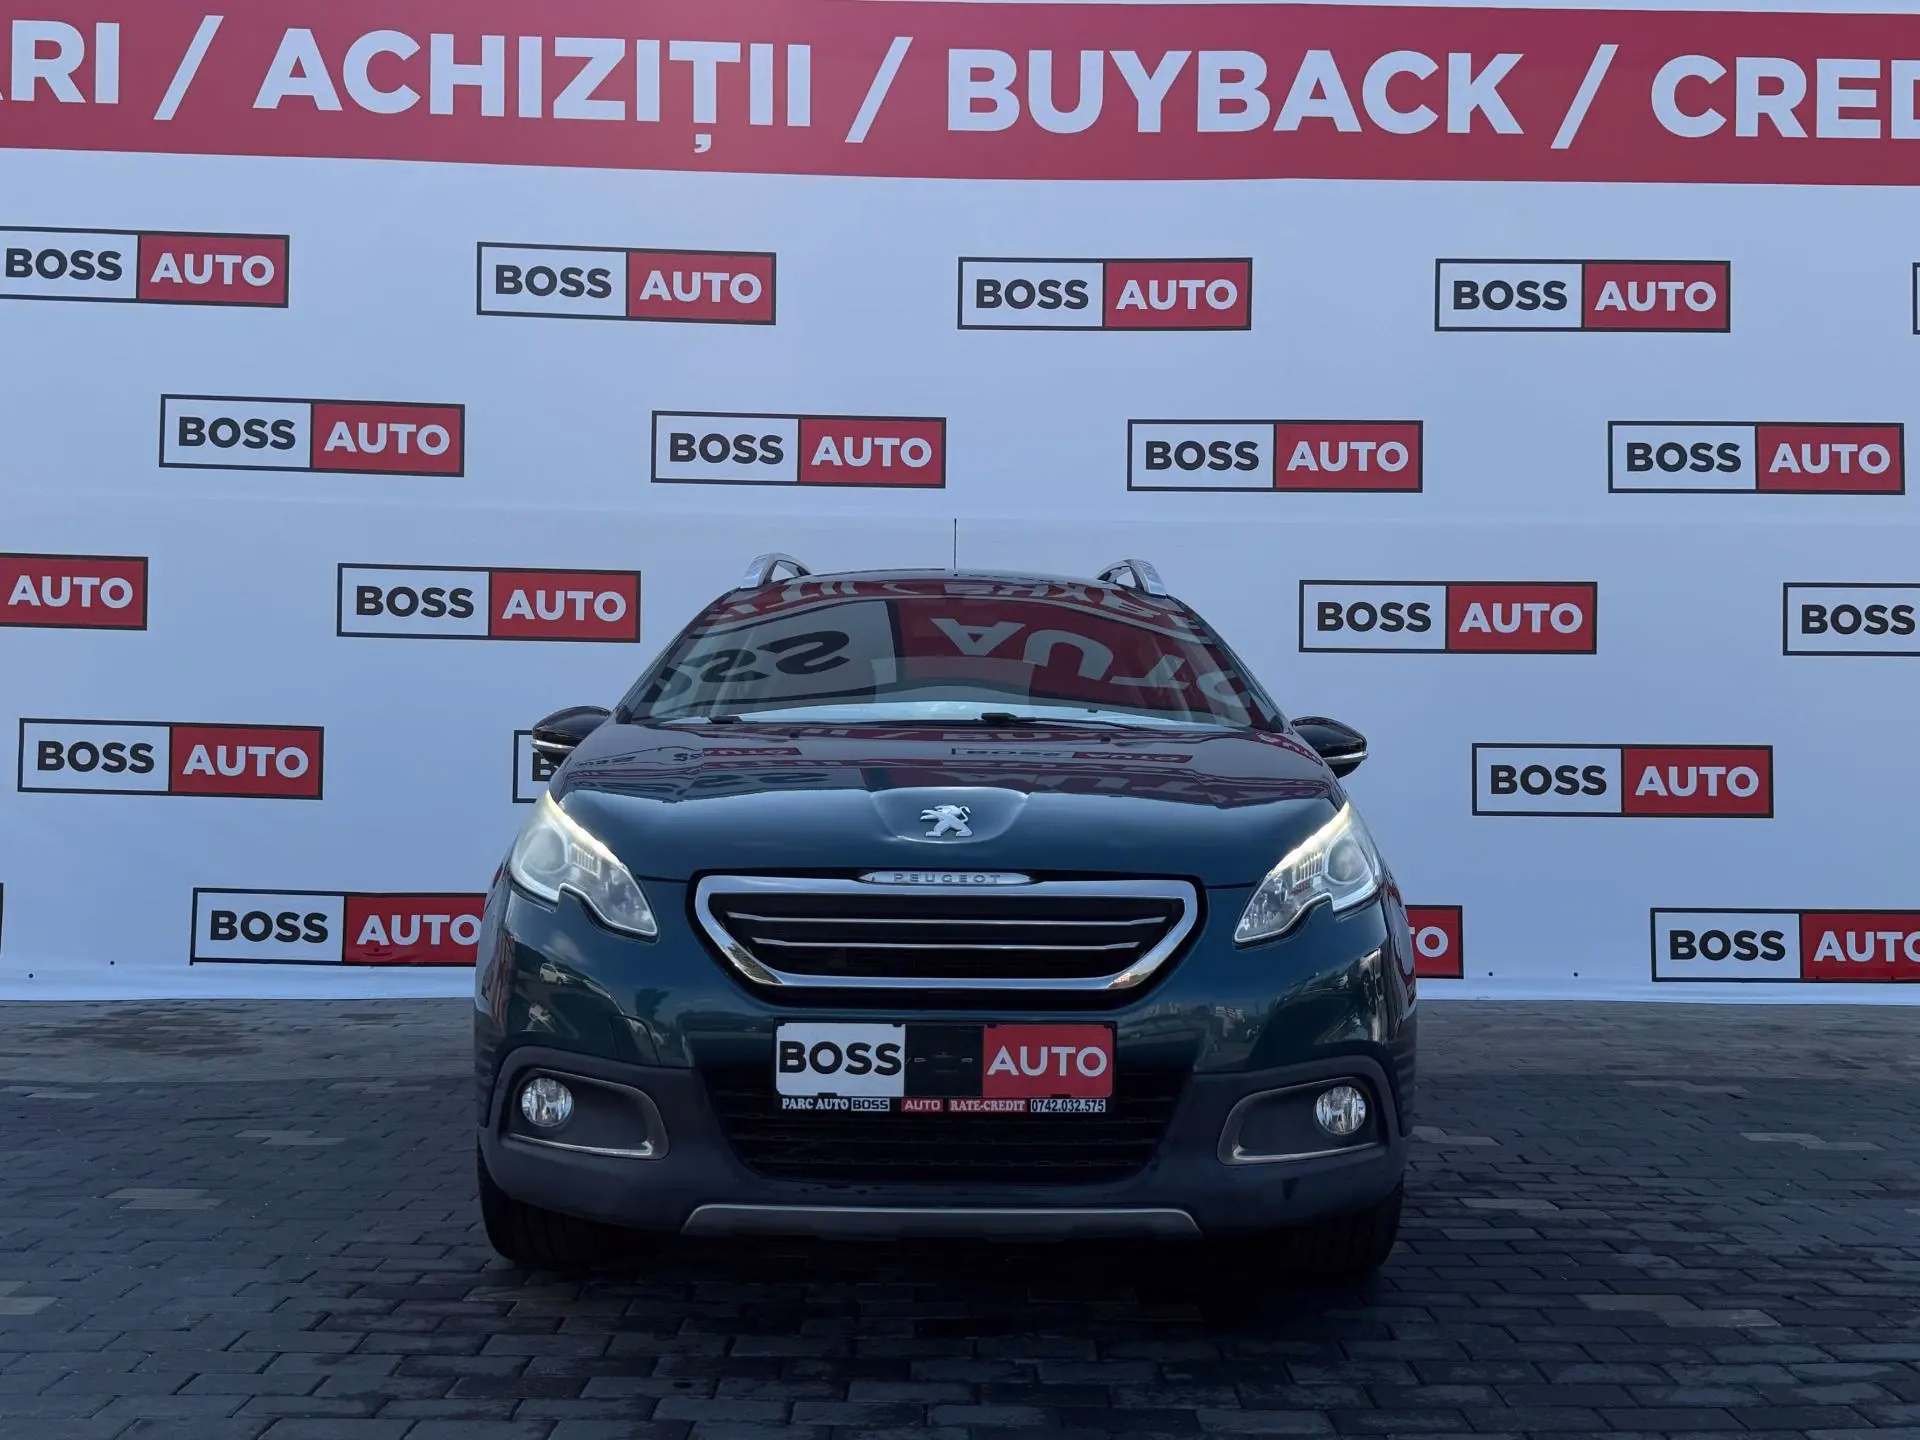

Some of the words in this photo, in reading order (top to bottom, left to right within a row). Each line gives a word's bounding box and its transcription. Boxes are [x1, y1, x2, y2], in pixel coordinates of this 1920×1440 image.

[0, 20, 119, 104] RI
[154, 15, 224, 120] /
[253, 28, 811, 153] ACHIZIȚII
[845, 37, 913, 143] /
[948, 49, 1524, 134] BUYBACK
[1551, 44, 1618, 149] /
[6, 248, 122, 281] BOSS
[151, 253, 274, 286] AUTO
[496, 265, 611, 298] BOSS
[640, 271, 761, 303] AUTO
[977, 279, 1088, 309] BOSS
[1116, 279, 1237, 310] AUTO
[1454, 281, 1567, 310] BOSS
[1595, 281, 1716, 311] AUTO
[179, 417, 295, 449] BOSS
[324, 422, 450, 455] AUTO
[670, 433, 783, 464] BOSS
[811, 436, 932, 467] AUTO
[1146, 441, 1259, 471] BOSS
[1287, 441, 1408, 472] AUTO
[1627, 442, 1741, 472] BOSS
[1769, 443, 1890, 474] AUTO
[9, 575, 132, 608] AUTO
[357, 586, 474, 618] BOSS
[502, 590, 626, 621] AUTO
[1318, 602, 1431, 632] BOSS
[1459, 603, 1582, 633] AUTO
[1802, 605, 1915, 635] BOSS
[38, 741, 154, 773] BOSS
[183, 745, 308, 778] AUTO
[1491, 765, 1606, 795] BOSS
[1636, 766, 1758, 797] AUTO
[893, 872, 1001, 884] PEUGEOT
[210, 910, 328, 943] BOSS
[357, 914, 481, 946] AUTO
[1670, 930, 1785, 961] BOSS
[779, 1041, 902, 1076] BOSS
[986, 1045, 1107, 1077] AUTO
[782, 1098, 813, 1110] PARC
[816, 1098, 848, 1110] AUTO
[852, 1099, 888, 1111] BOSS
[904, 1100, 940, 1111] AUTO
[950, 1099, 1025, 1111] RATE-CREDIT
[1031, 1099, 1105, 1112] 0742.032.575
